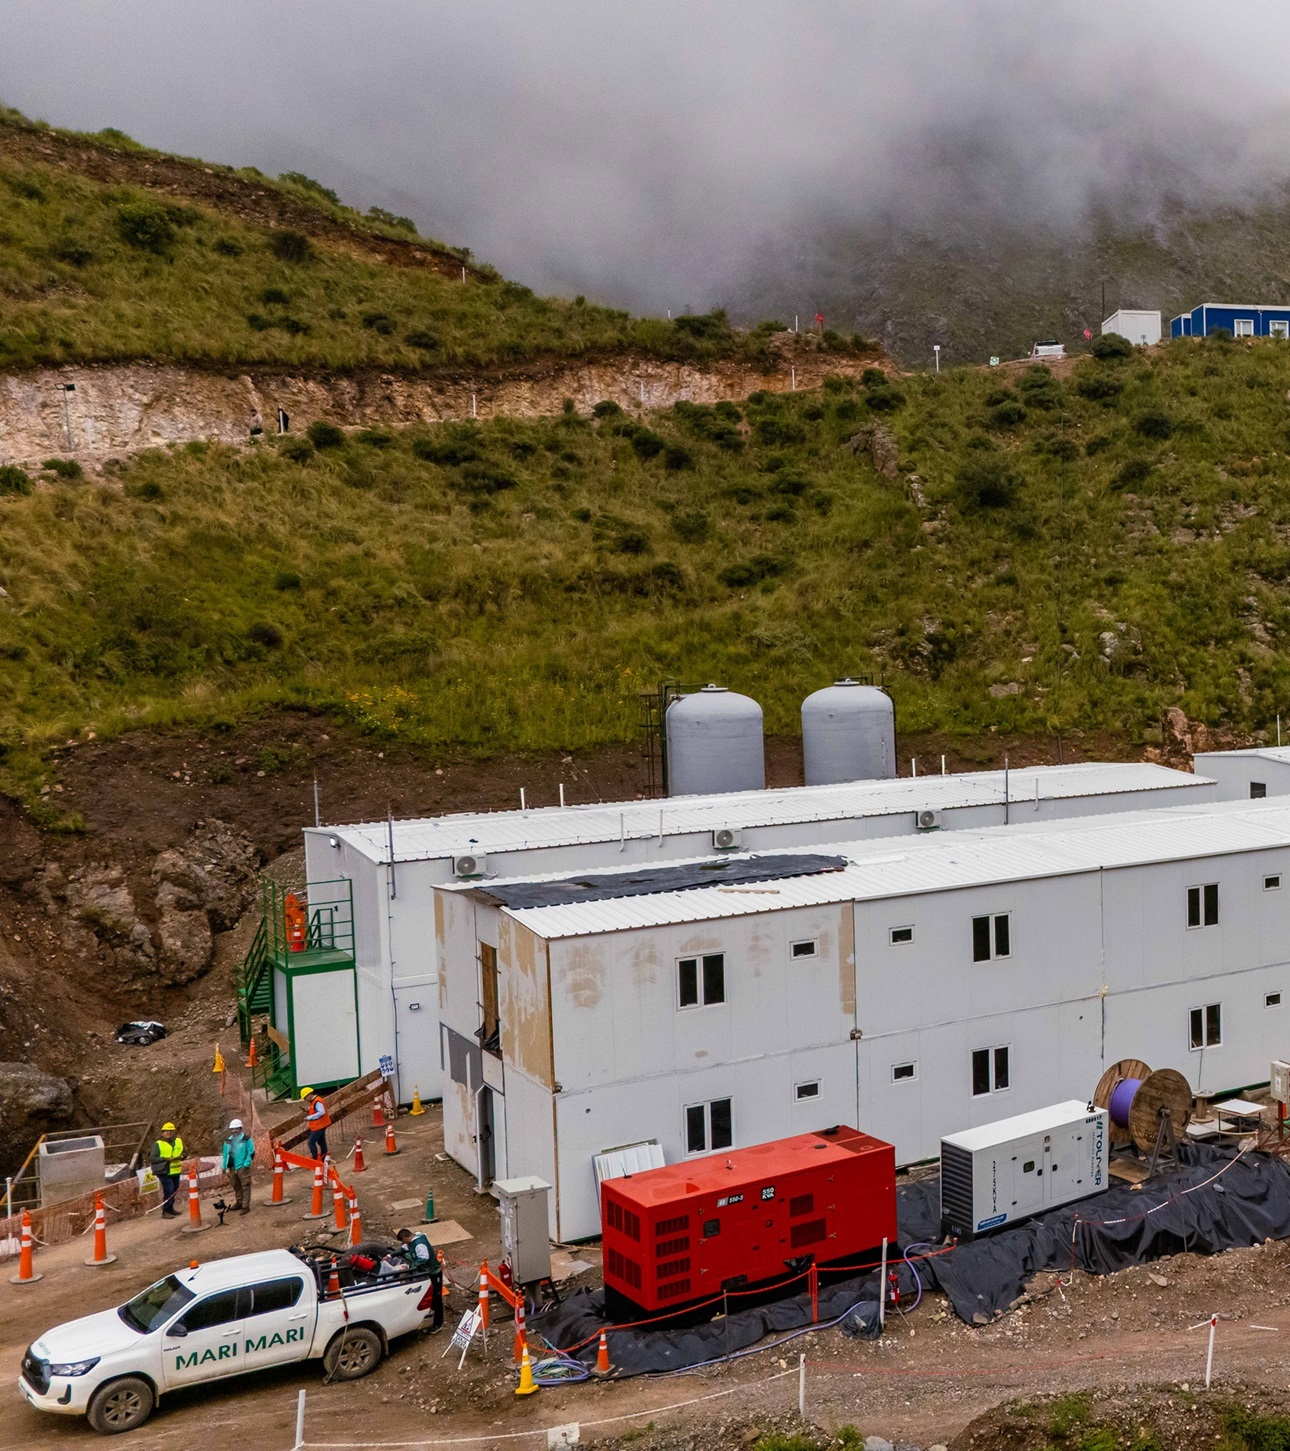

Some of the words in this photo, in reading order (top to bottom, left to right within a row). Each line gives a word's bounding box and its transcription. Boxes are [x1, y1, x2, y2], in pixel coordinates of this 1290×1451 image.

[762, 1187, 775, 1195] 550
[175, 1343, 238, 1371] MARI
[245, 1326, 305, 1354] MARI
